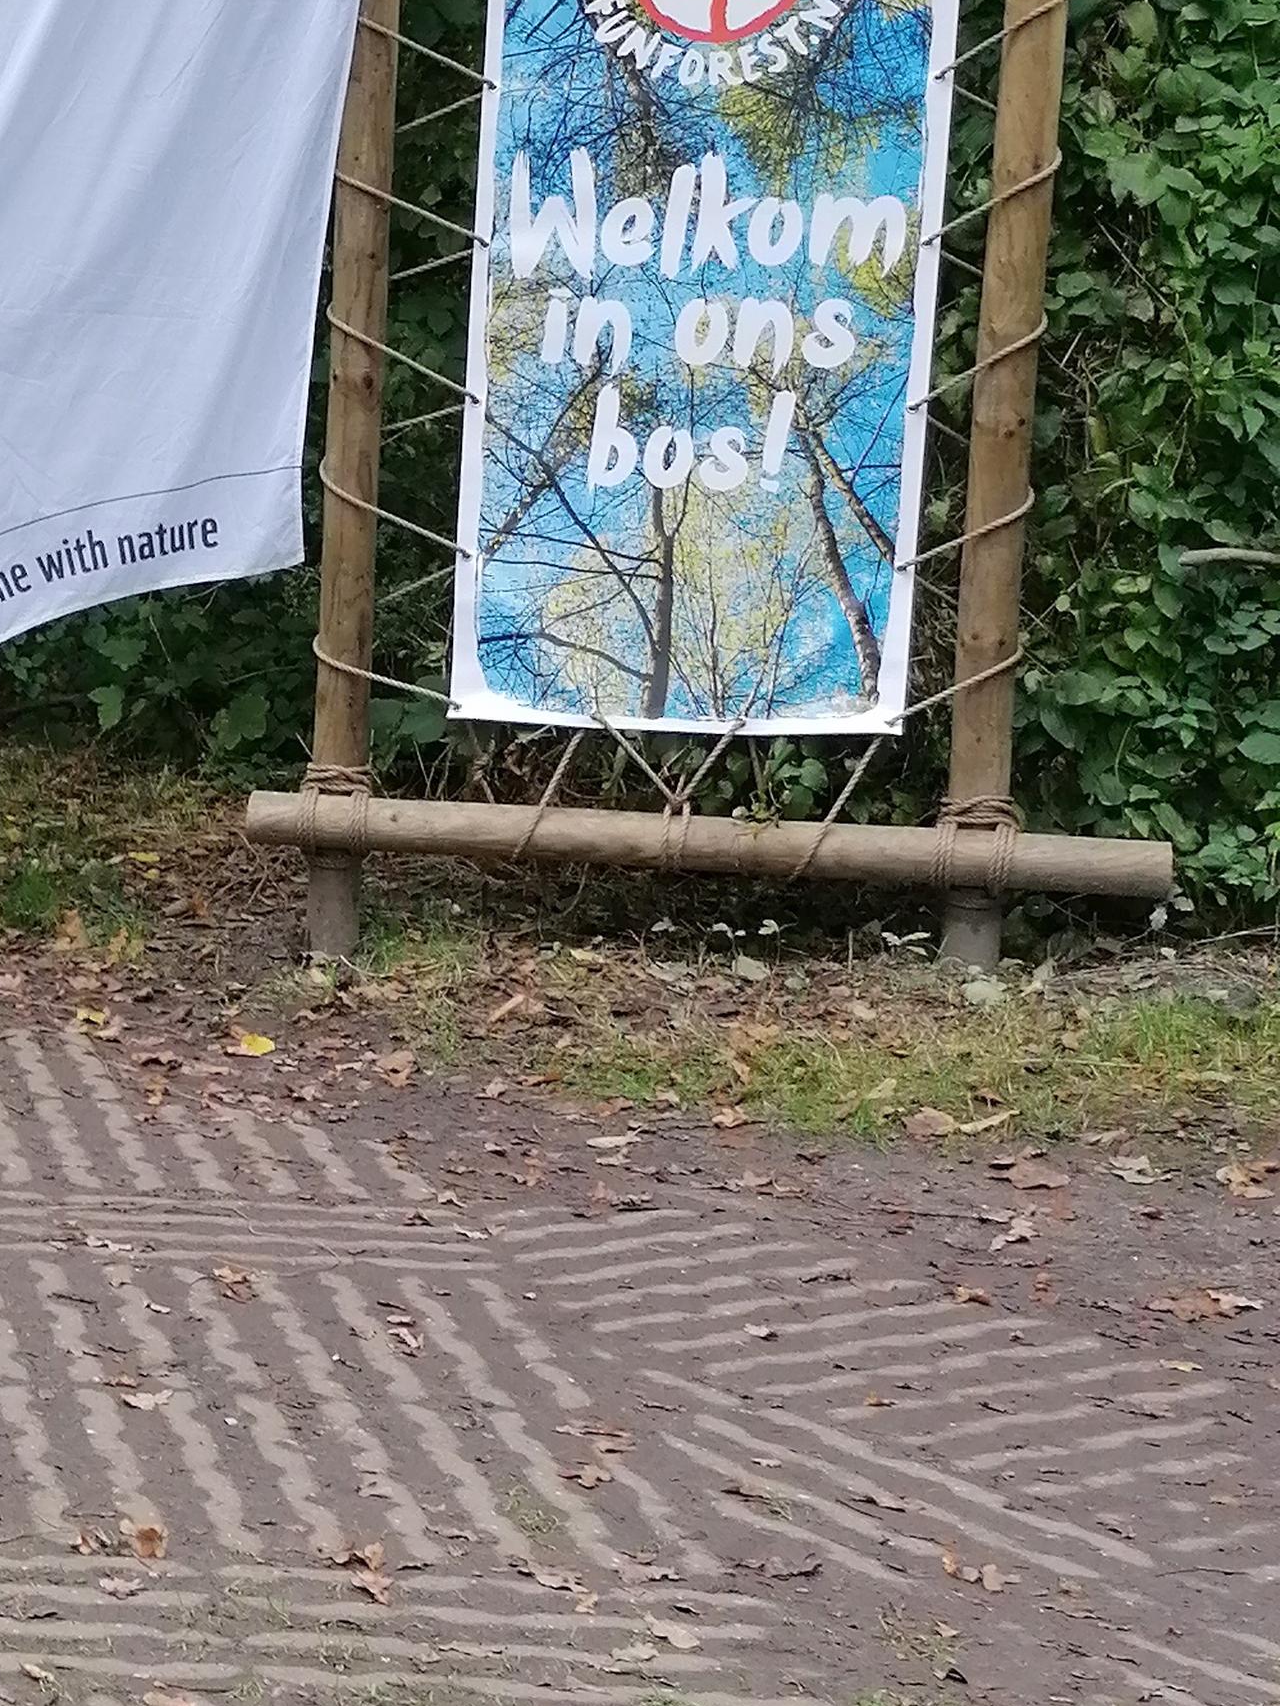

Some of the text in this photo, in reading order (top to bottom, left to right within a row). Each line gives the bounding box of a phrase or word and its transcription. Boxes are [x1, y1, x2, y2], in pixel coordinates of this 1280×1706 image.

[510, 146, 907, 281] Welkom
[541, 289, 856, 378] in ons
[587, 385, 798, 494] bos!
[35, 529, 109, 583] with
[117, 516, 219, 566] nature
